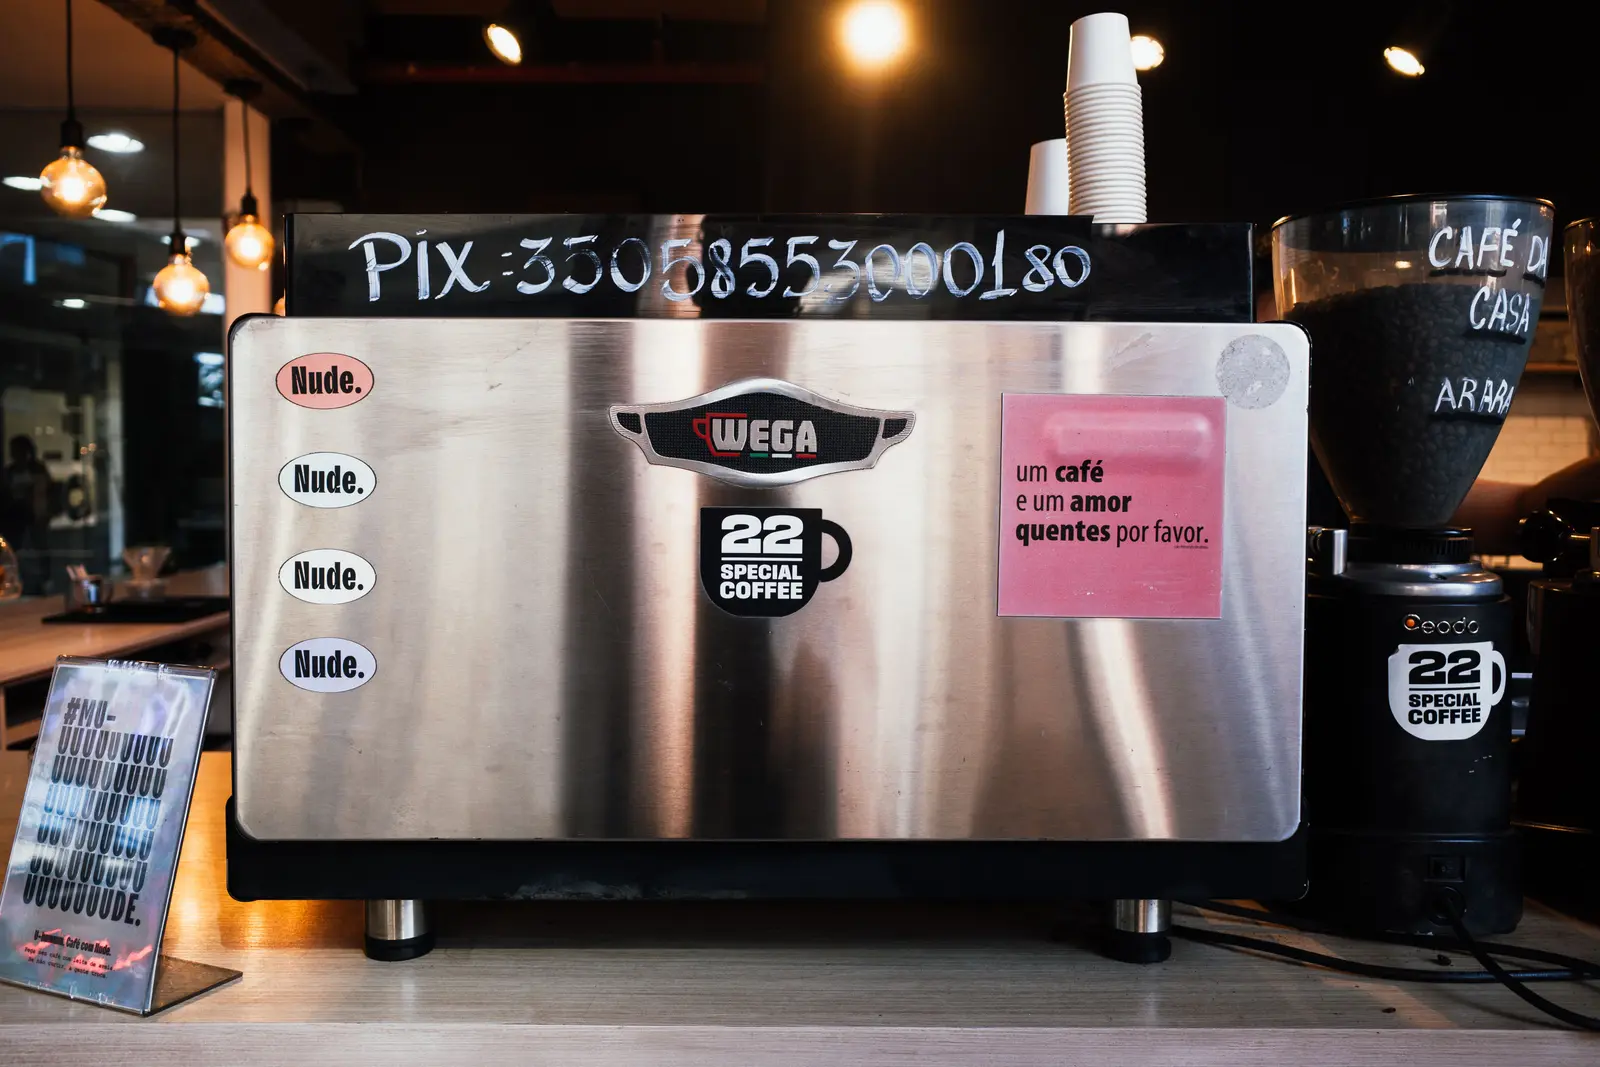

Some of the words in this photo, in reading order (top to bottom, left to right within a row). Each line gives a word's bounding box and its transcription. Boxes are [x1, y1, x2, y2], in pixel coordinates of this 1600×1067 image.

[1429, 218, 1521, 269] CAFÉ
[1469, 285, 1530, 334] CASA
[291, 365, 362, 395] Nude.
[712, 418, 818, 453] WEGA
[294, 464, 364, 495] Nude.
[1016, 464, 1047, 482] um
[1055, 459, 1104, 483] café
[1016, 494, 1027, 511] e
[1033, 494, 1064, 512] um
[1070, 494, 1132, 513] amor
[721, 514, 804, 554] 22
[1015, 520, 1110, 546] quentes
[1117, 524, 1149, 548] por
[1153, 519, 1209, 543] favor.
[294, 561, 364, 591] Nude.
[720, 563, 802, 580] SPECIAL
[719, 581, 803, 599] COFFEE
[294, 649, 365, 679] Nude.
[1408, 649, 1481, 685] 22
[63, 697, 116, 729] #MU-
[1408, 693, 1481, 708] SPECIAL
[1408, 707, 1481, 725] COFFEE
